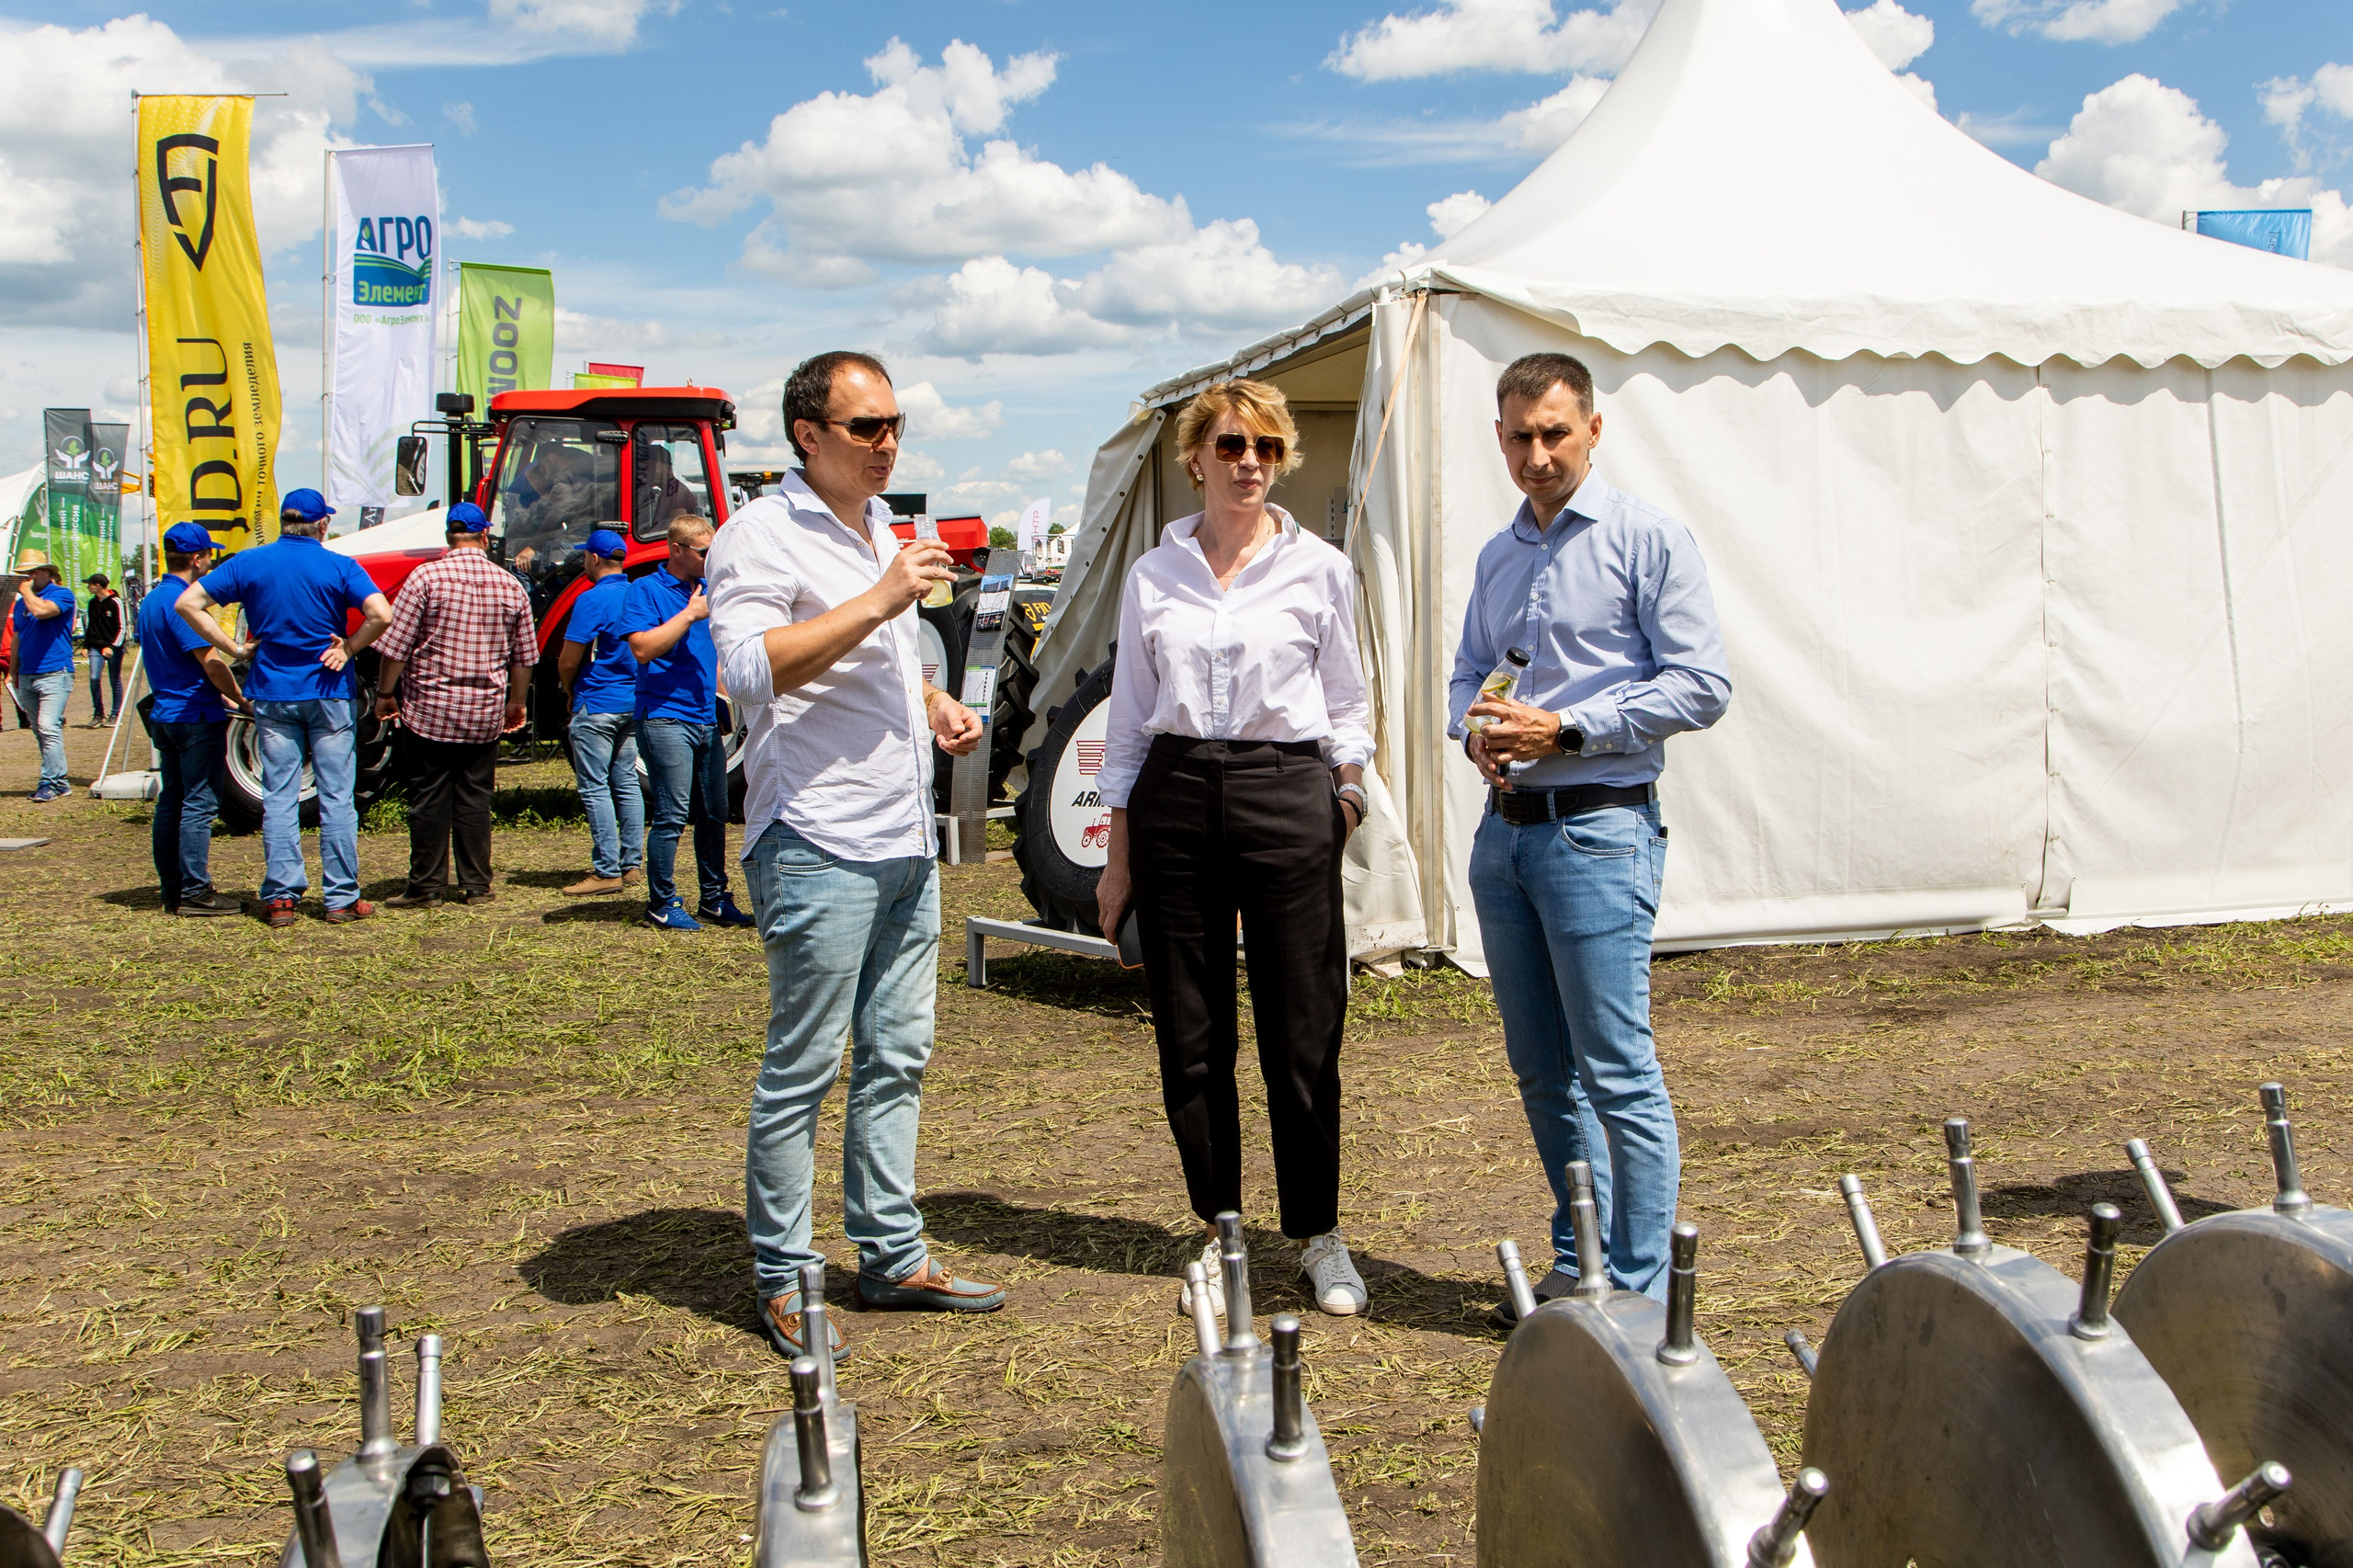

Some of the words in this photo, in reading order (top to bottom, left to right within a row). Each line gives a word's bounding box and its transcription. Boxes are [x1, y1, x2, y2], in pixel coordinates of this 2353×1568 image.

[356, 215, 433, 261] АГРО
[358, 280, 426, 303] Элемент
[354, 313, 372, 324] ООО
[242, 341, 265, 427] земледелия
[54, 471, 90, 481] ШАНС
[254, 431, 267, 486] точного
[94, 482, 119, 491] ШАНС
[60, 510, 72, 558] растений
[71, 505, 82, 561] профессия
[73, 562, 82, 588] наша
